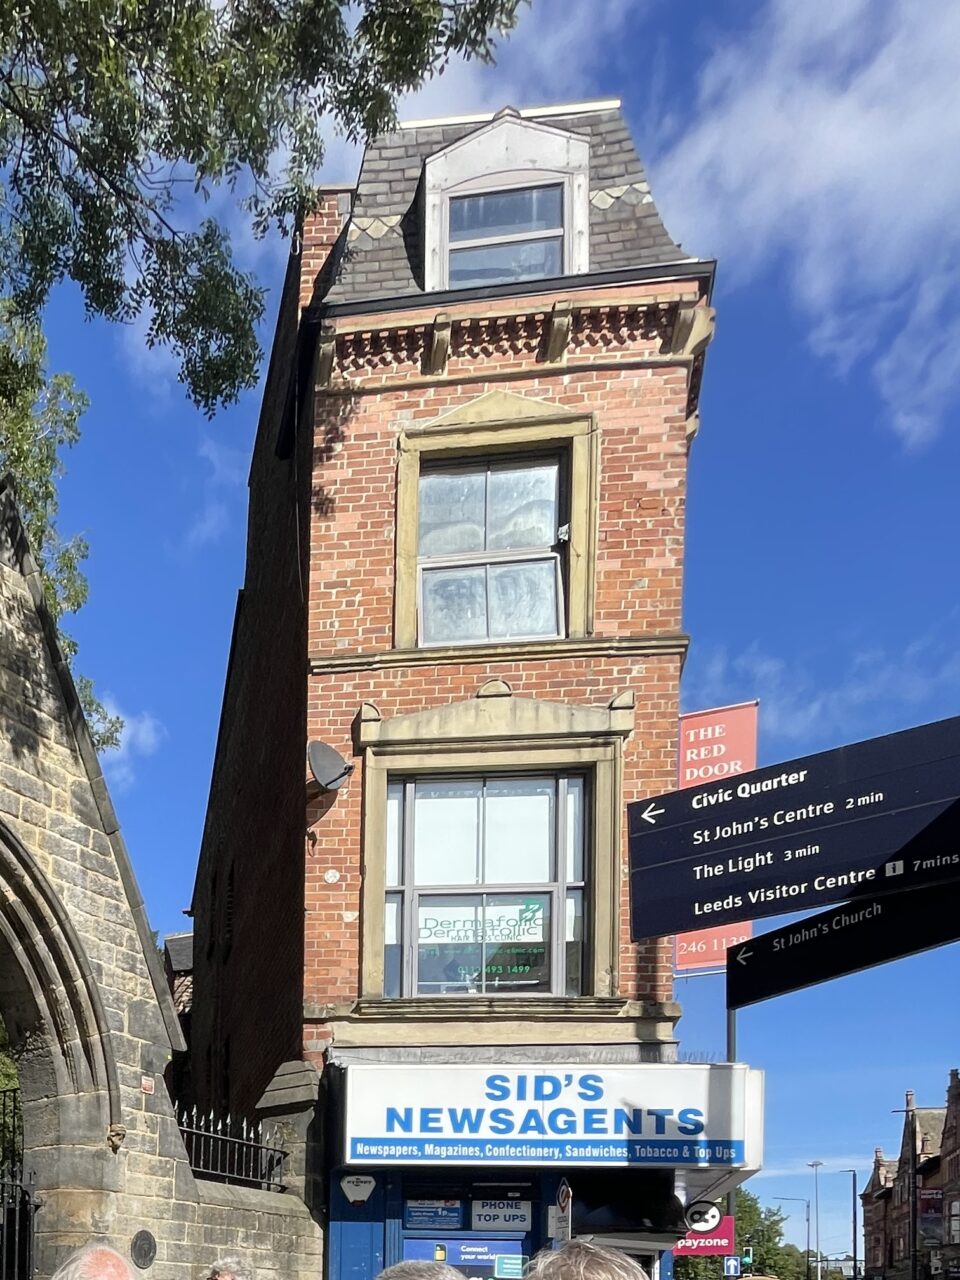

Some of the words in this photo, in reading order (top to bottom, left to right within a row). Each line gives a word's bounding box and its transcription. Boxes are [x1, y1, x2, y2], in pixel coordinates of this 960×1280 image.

[686, 724, 726, 743] THE
[686, 743, 726, 762] RED
[685, 760, 743, 781] DOOR
[692, 789, 732, 809] Civic
[737, 769, 808, 798] Quarter
[693, 830, 710, 845] St
[714, 817, 769, 841] John’s
[773, 802, 834, 826] Centre
[845, 798, 855, 809] 2
[857, 791, 884, 807] min
[693, 863, 724, 880] The
[728, 851, 774, 874] Light
[784, 850, 792, 861] 3
[795, 844, 820, 859] min
[694, 896, 743, 915] Leeds
[748, 881, 808, 904] Visitor
[814, 868, 876, 892] Centre
[773, 938, 785, 952] St
[832, 902, 882, 930] Church
[451, 934, 470, 942] HAIR
[495, 934, 522, 942] CLINIC
[678, 940, 706, 955] 246
[507, 965, 530, 974] 1499
[485, 1074, 605, 1101] SID’S
[385, 1107, 705, 1135] NEWSAGENTS
[356, 1143, 422, 1157] Newspapers,
[424, 1143, 484, 1158] Magazines,
[486, 1144, 562, 1159] Confectionery,
[565, 1144, 632, 1159] Sandwiches,
[635, 1145, 679, 1158] Tobacco
[682, 1146, 690, 1158] &
[693, 1146, 712, 1160] Top
[715, 1147, 736, 1161] Ups
[481, 1201, 522, 1210] PHONE
[476, 1213, 499, 1222] TOP
[504, 1214, 527, 1222] UPS
[677, 1238, 729, 1249] payzone
